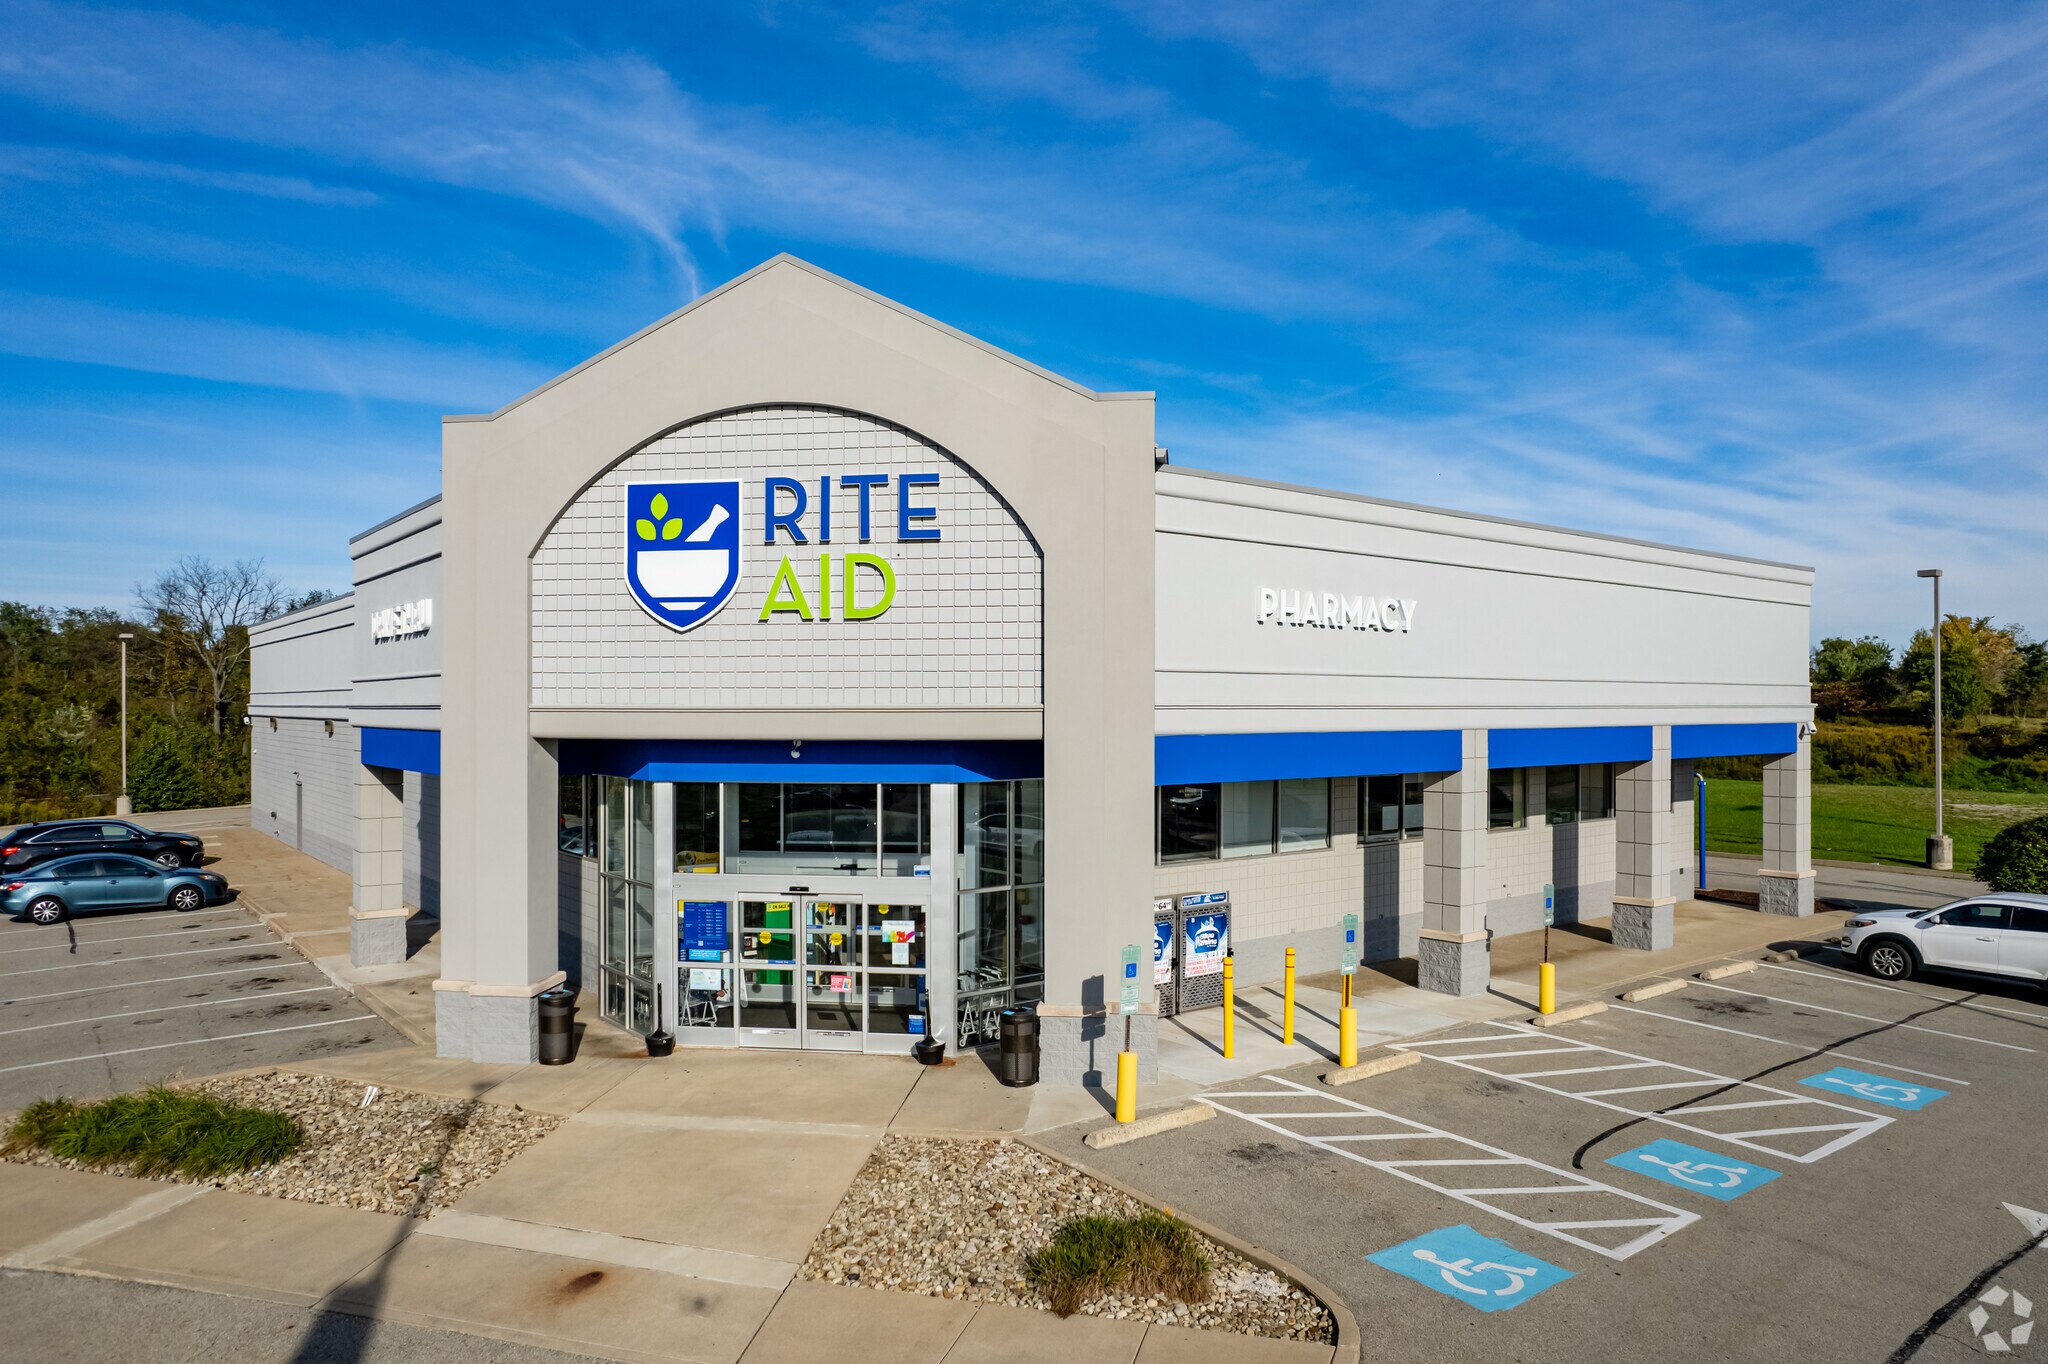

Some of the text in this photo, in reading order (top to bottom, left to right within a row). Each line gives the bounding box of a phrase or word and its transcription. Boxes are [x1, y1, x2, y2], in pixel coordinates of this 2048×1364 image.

[764, 473, 941, 544] RITE
[759, 552, 897, 622] AID
[1256, 587, 1417, 633] PHARMACY
